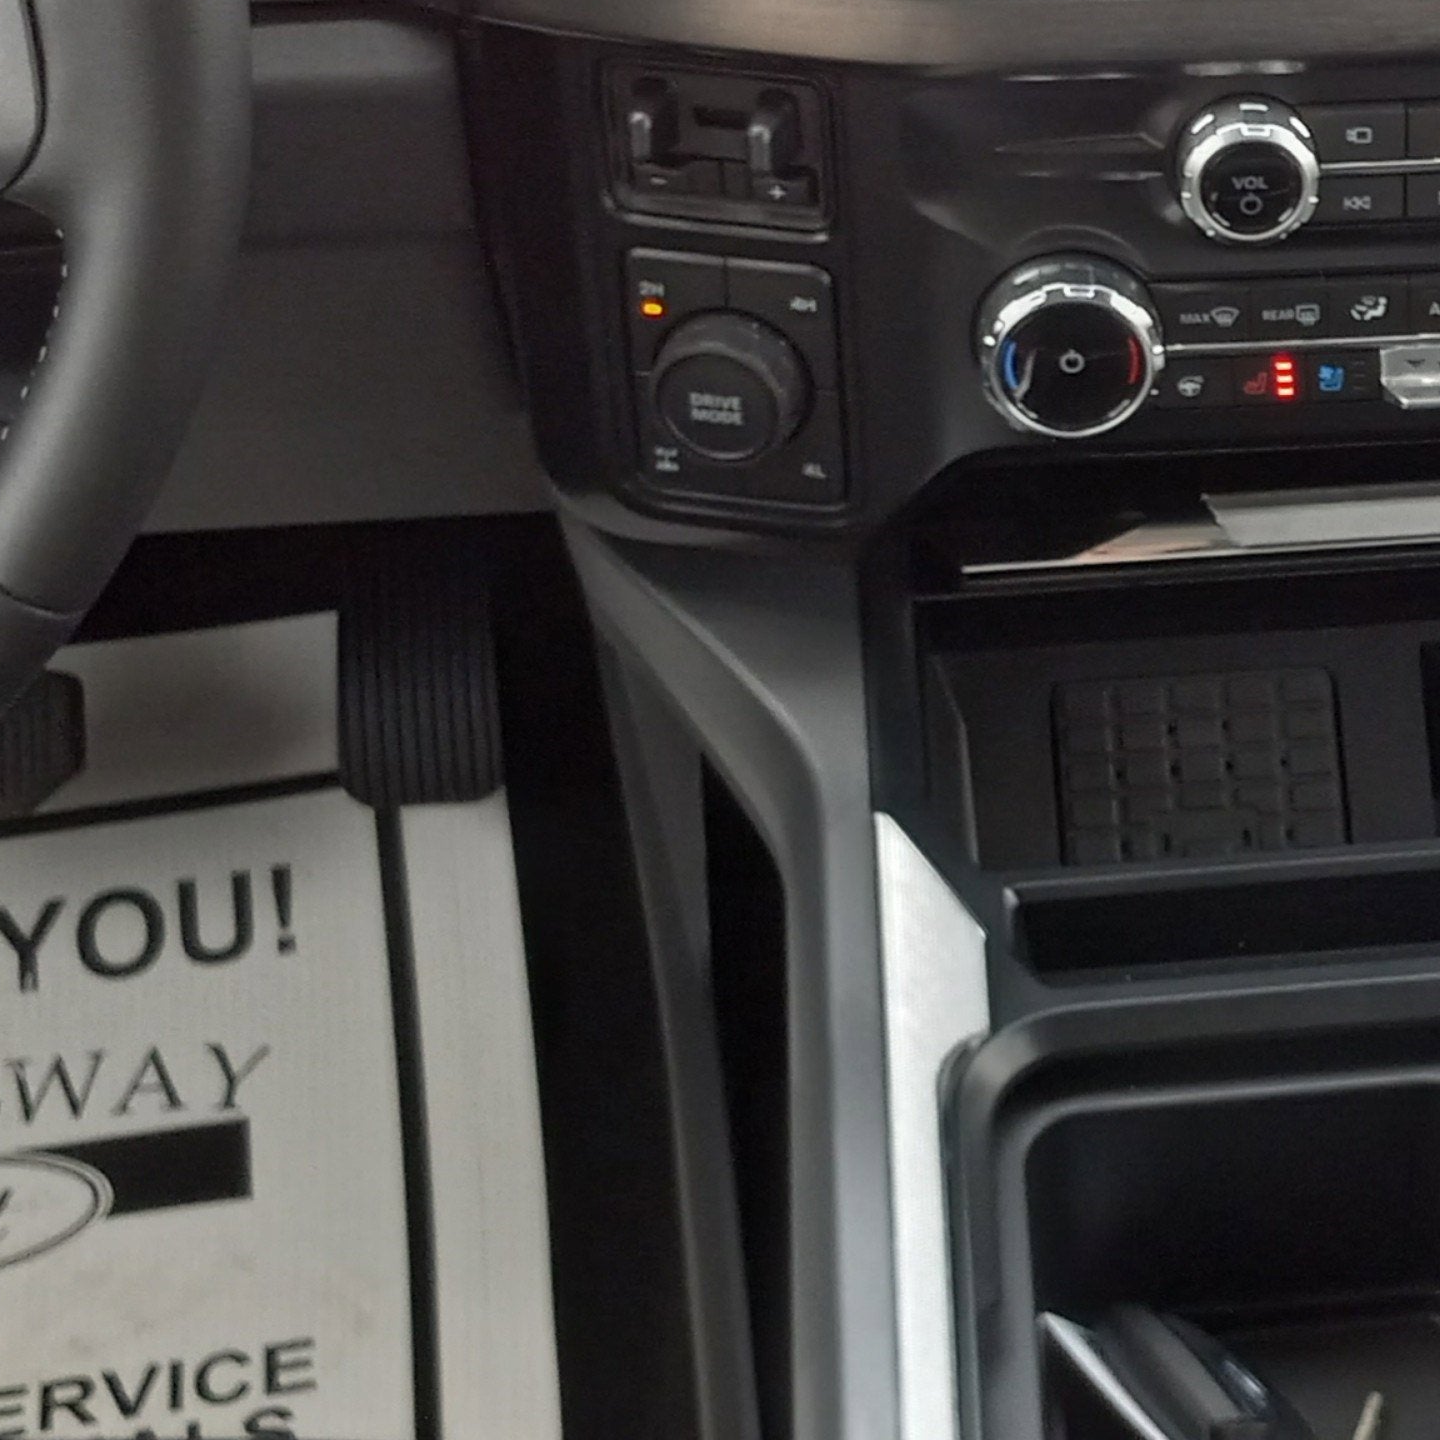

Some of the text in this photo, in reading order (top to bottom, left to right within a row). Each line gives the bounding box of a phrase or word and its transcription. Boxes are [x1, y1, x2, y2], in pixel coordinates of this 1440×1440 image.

[1231, 176, 1269, 190] VOL
[688, 391, 743, 410] DRIVE
[689, 407, 744, 426] MODE
